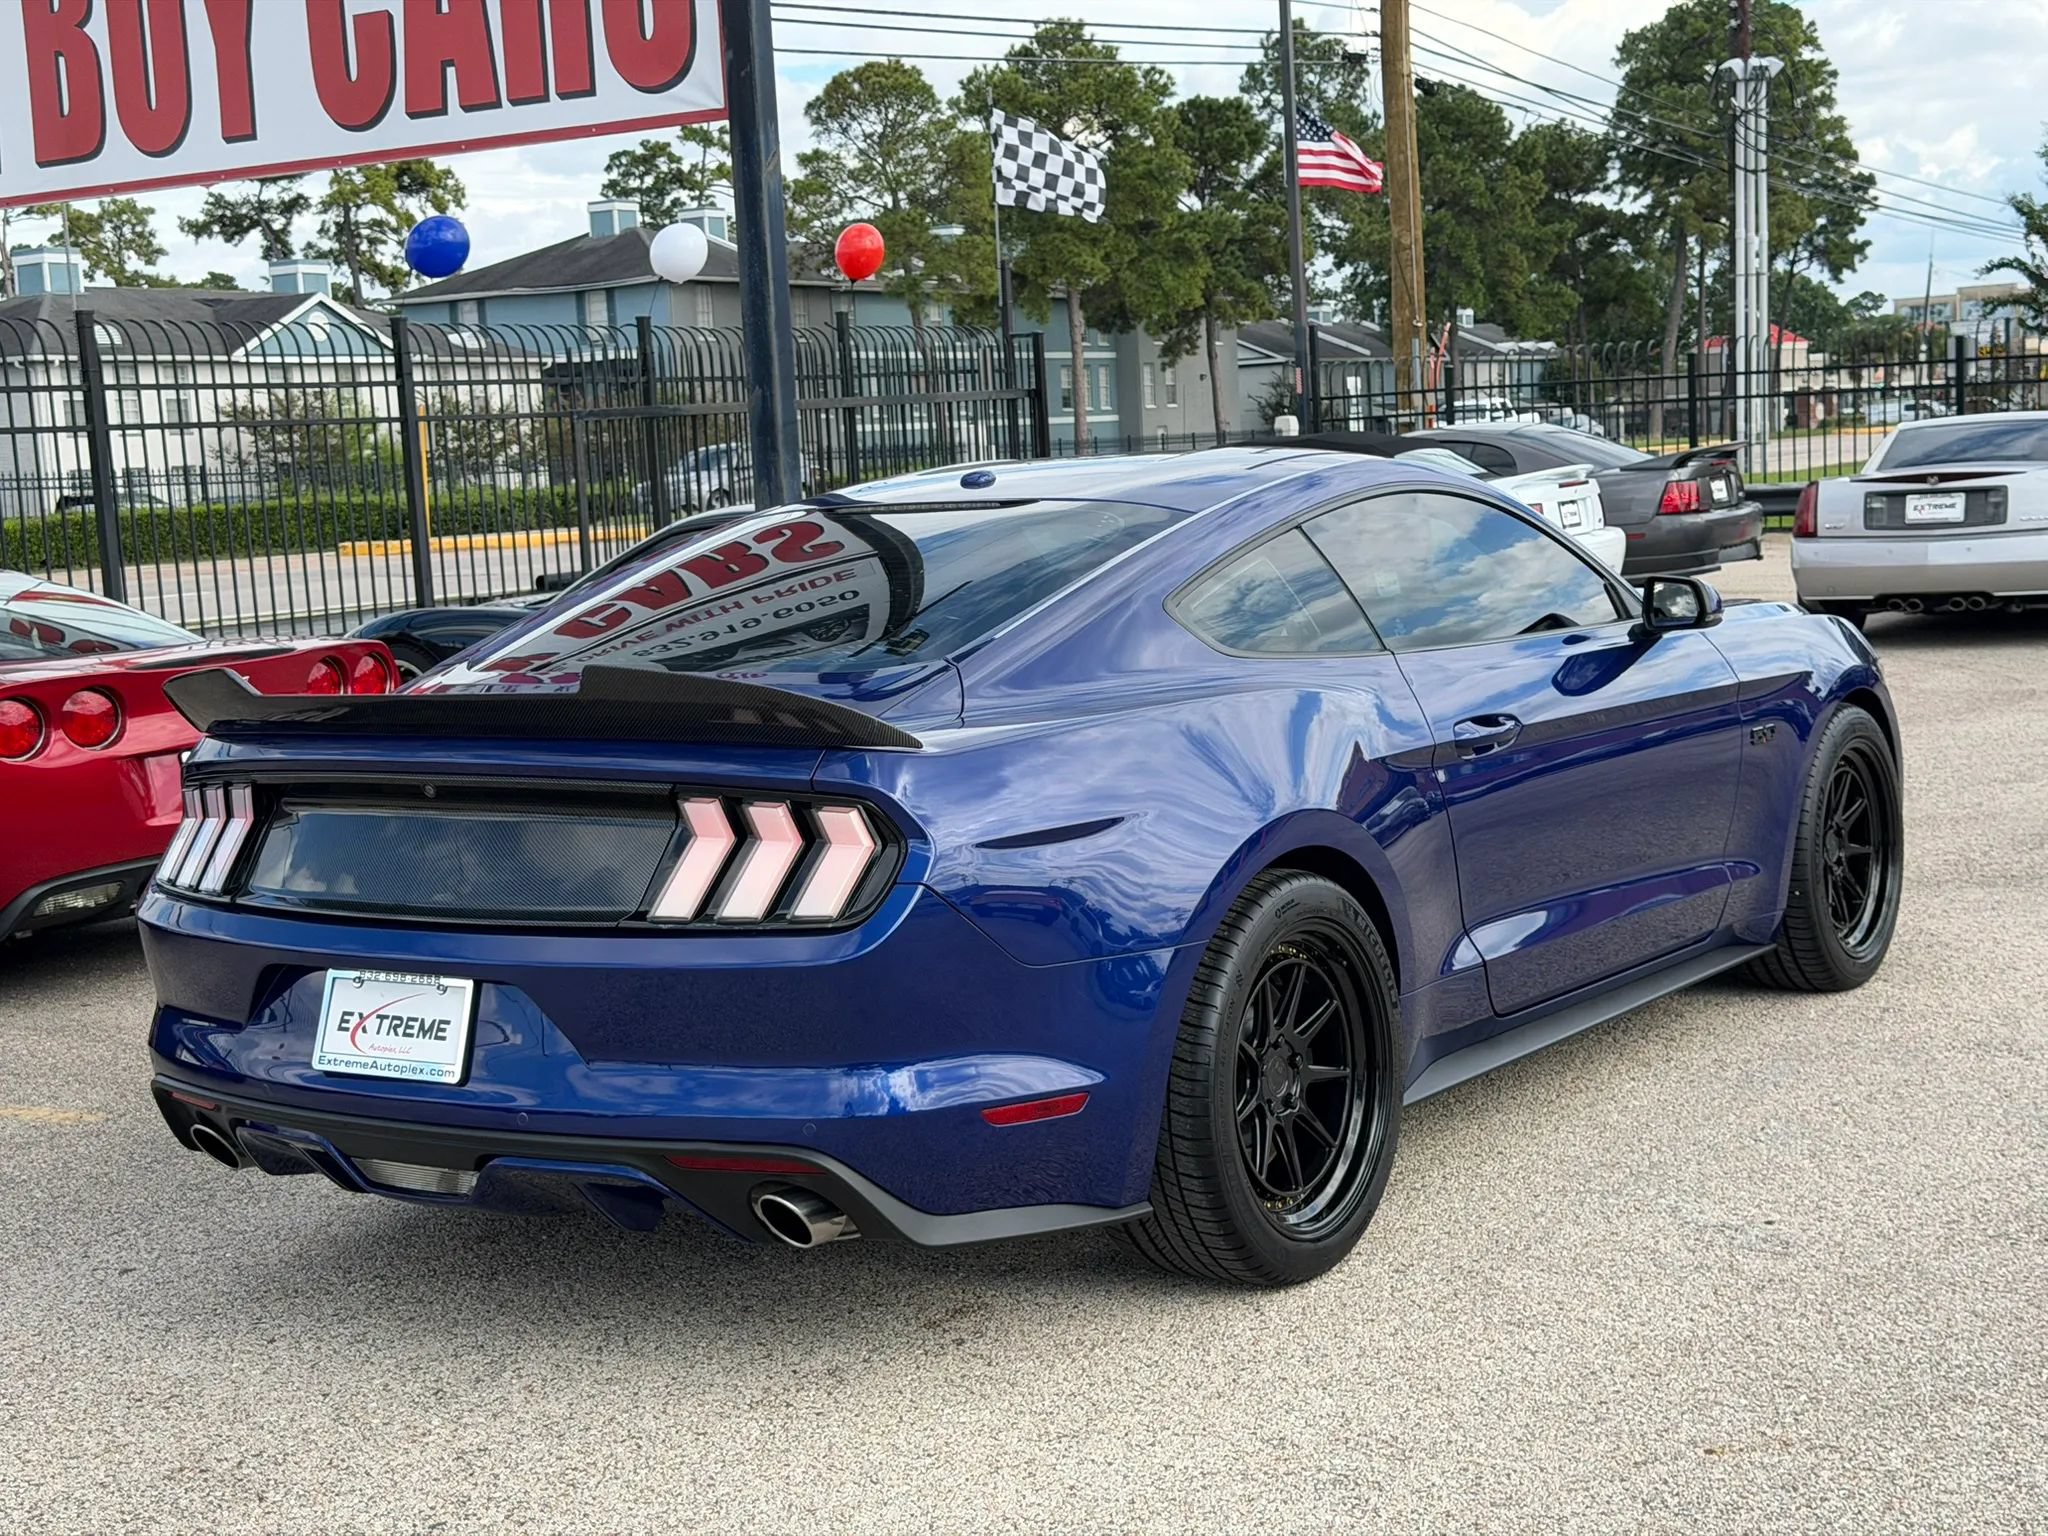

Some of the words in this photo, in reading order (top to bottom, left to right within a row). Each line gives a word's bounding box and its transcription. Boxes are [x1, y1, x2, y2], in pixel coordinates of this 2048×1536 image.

[24, 0, 257, 168] BUY
[337, 1010, 452, 1042] EXTREME
[318, 1055, 456, 1079] ExtremeAutoplex.com
